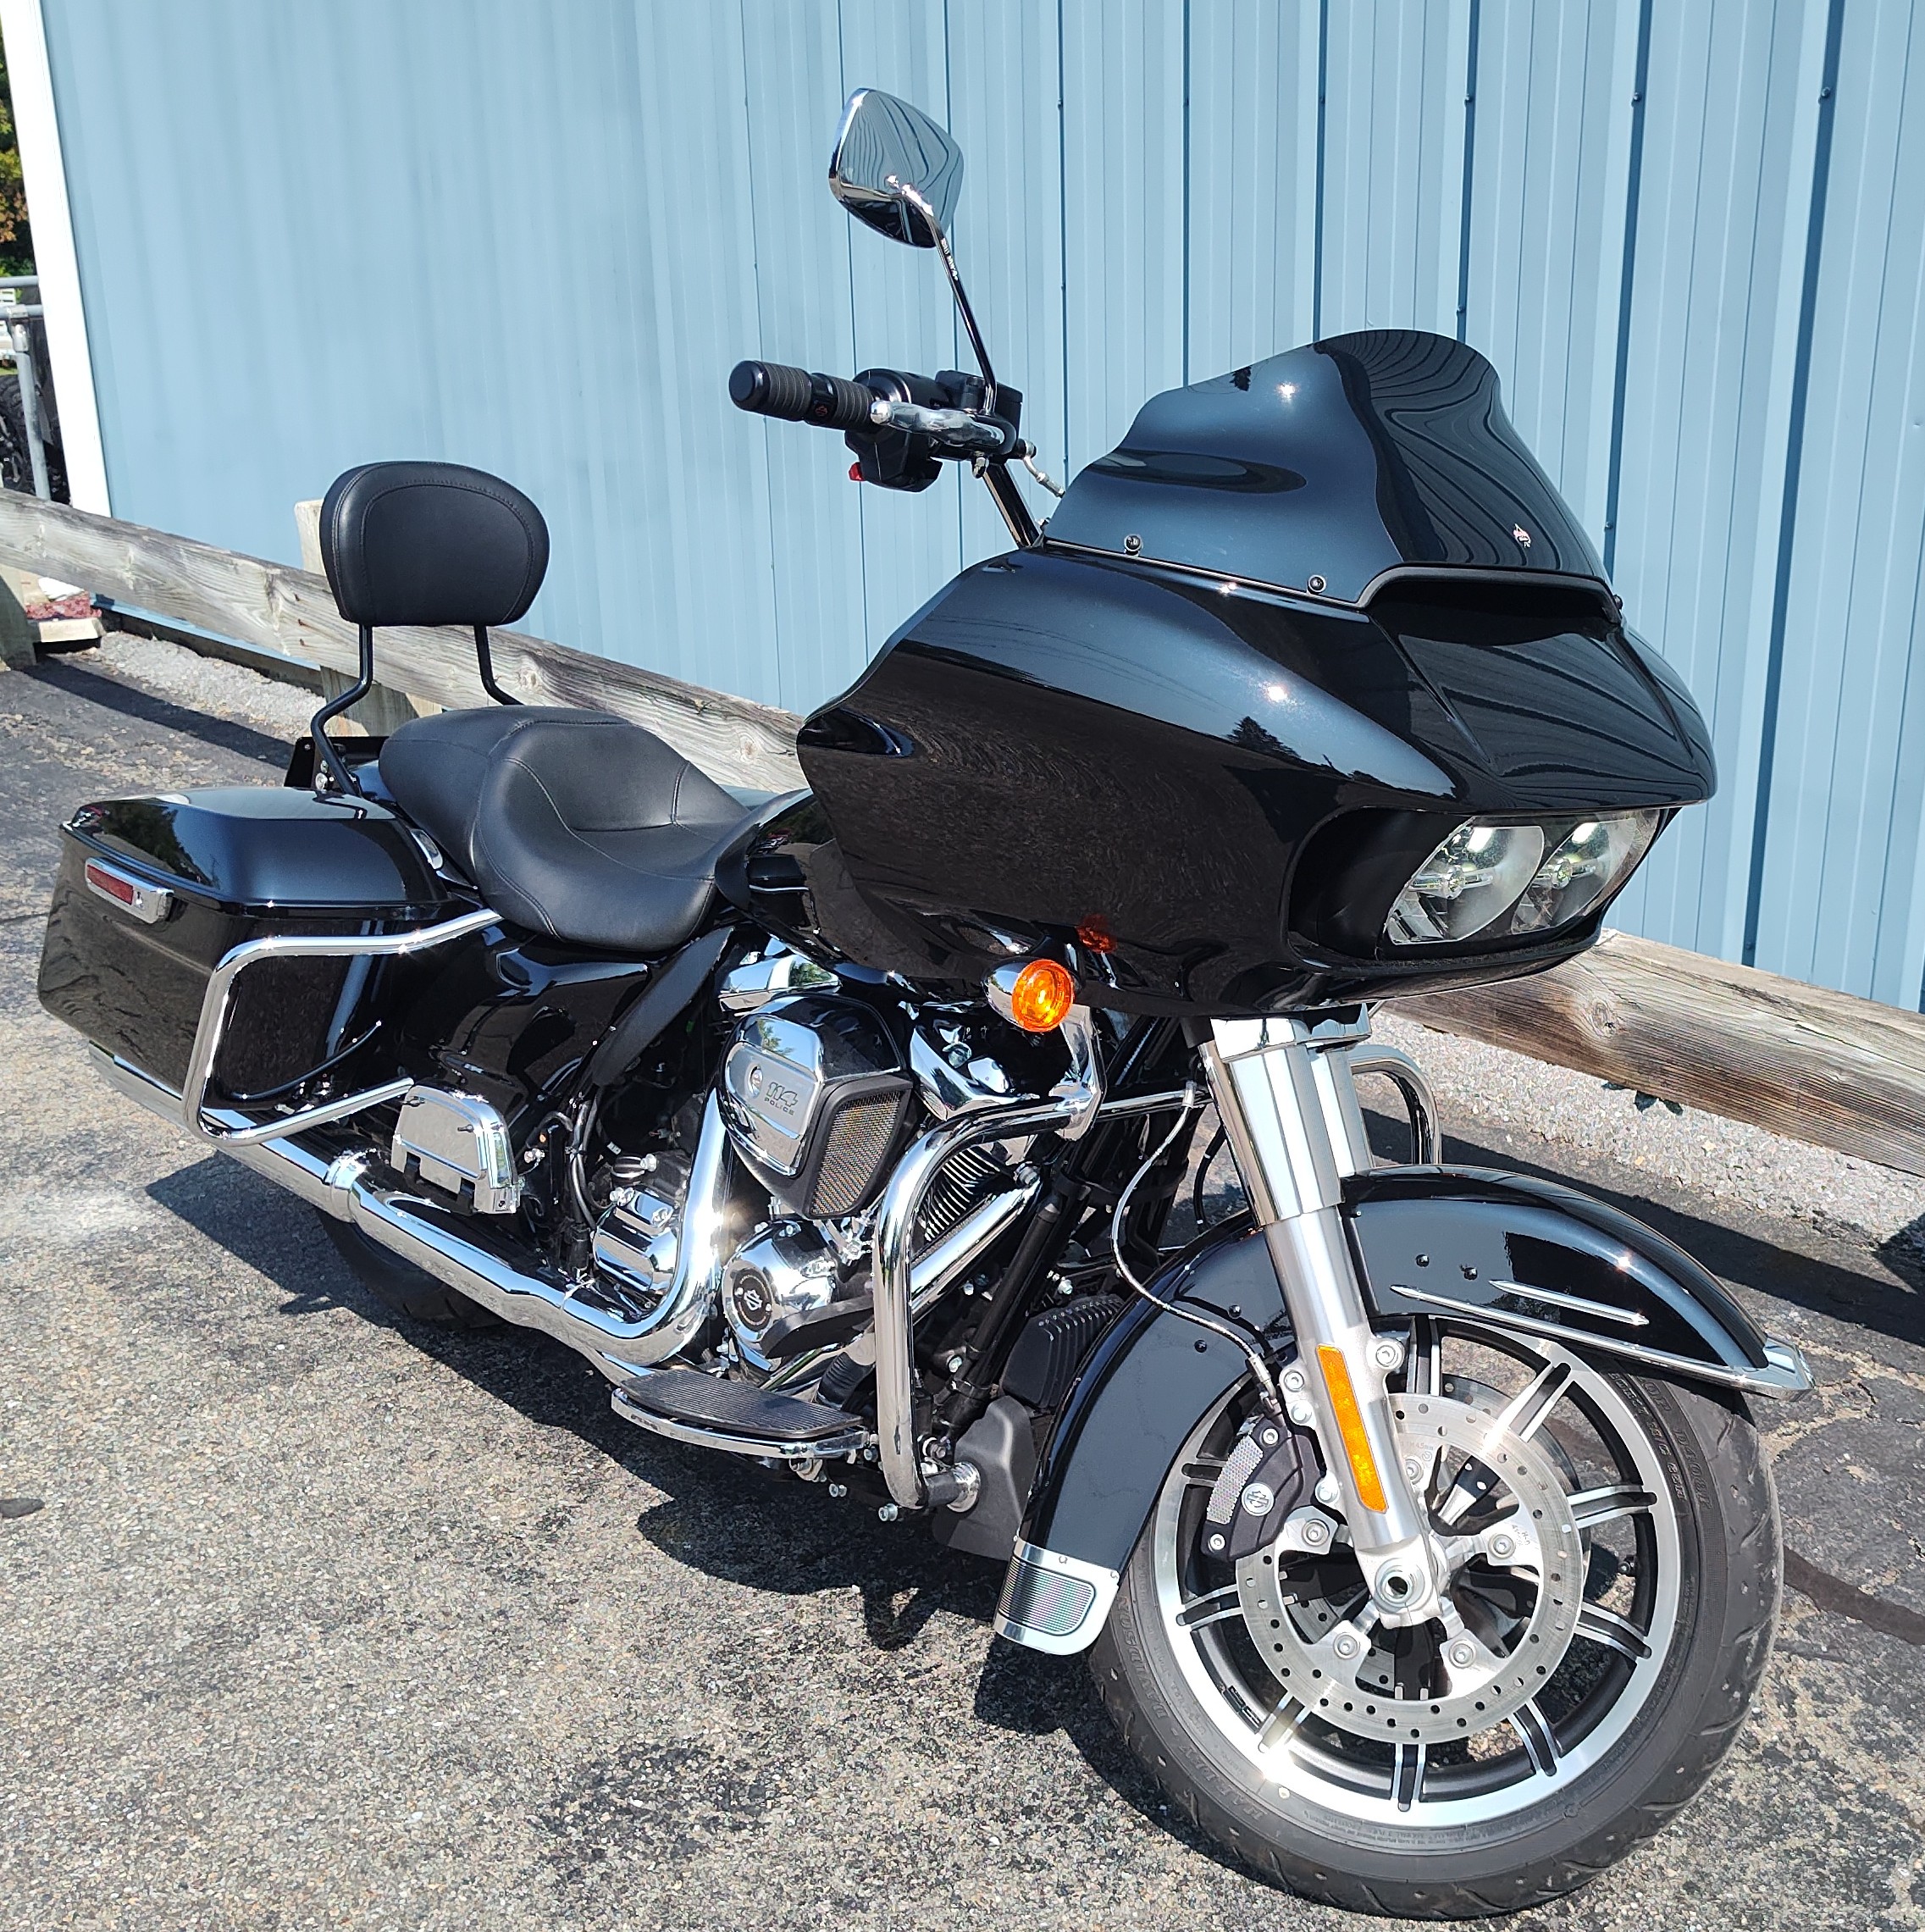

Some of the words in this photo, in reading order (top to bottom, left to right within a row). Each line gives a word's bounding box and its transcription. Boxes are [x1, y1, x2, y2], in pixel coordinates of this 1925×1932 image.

[764, 1096, 795, 1115] POLICE
[766, 1081, 799, 1108] 114
[1116, 1595, 1170, 1719] DAVIDSON
[1178, 1744, 1268, 1820] HARLEY
